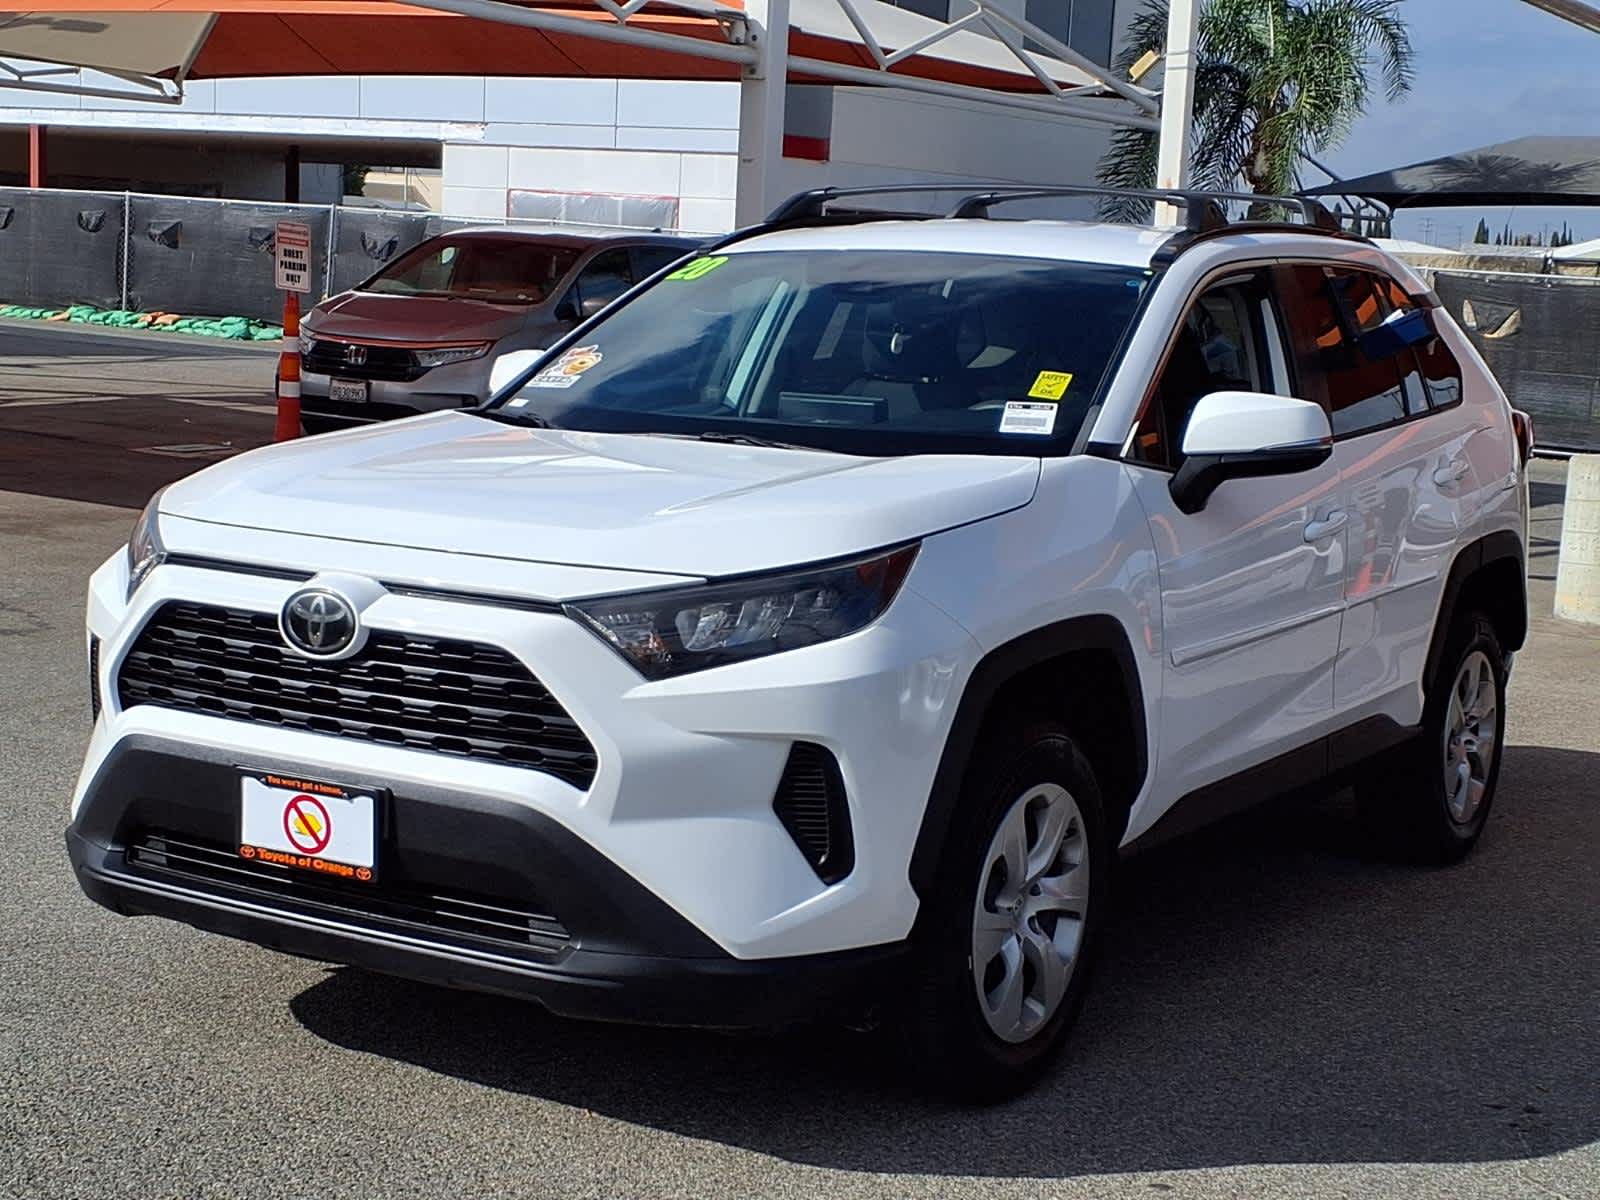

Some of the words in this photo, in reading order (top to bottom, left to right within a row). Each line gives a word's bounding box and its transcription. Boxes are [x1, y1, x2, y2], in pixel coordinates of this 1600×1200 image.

[280, 260, 306, 272] PARKING
[257, 848, 297, 866] Toyota
[298, 857, 312, 868] of
[313, 859, 354, 877] Orange
